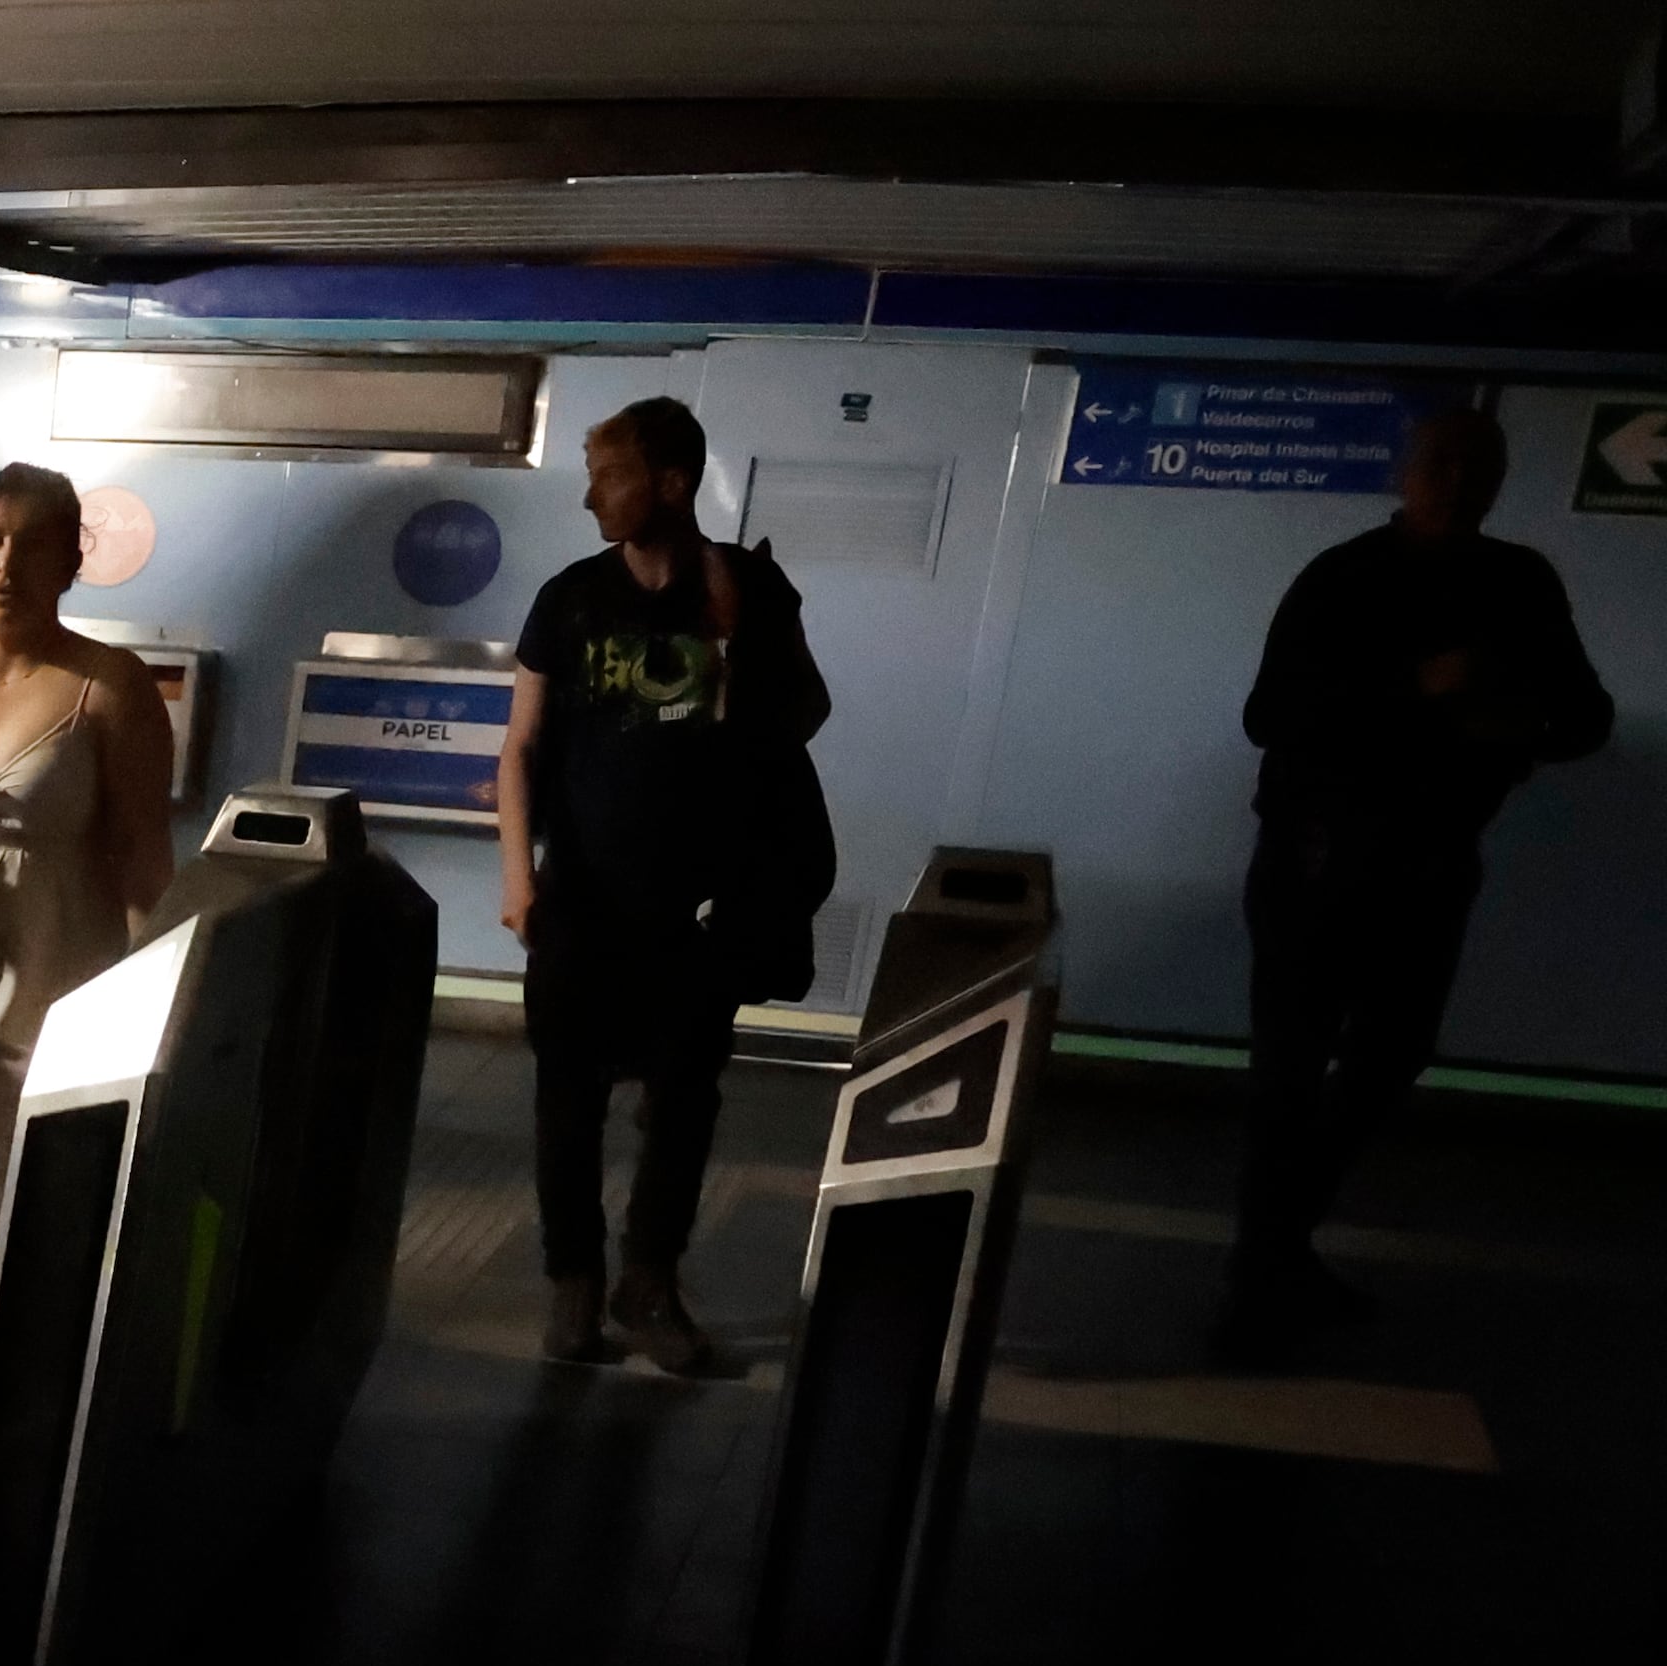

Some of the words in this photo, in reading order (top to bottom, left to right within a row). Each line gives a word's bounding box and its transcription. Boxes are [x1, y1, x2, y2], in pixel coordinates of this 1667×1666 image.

[1206, 384, 1254, 402] Pinar
[1261, 386, 1287, 403] de
[1202, 411, 1315, 430] Valdecarros
[1146, 444, 1188, 475] 10
[1195, 439, 1271, 460] Hospital
[1190, 464, 1254, 484] Puerta
[1258, 468, 1289, 484] del
[1294, 468, 1329, 486] Sur
[381, 720, 452, 741] PAPEL
